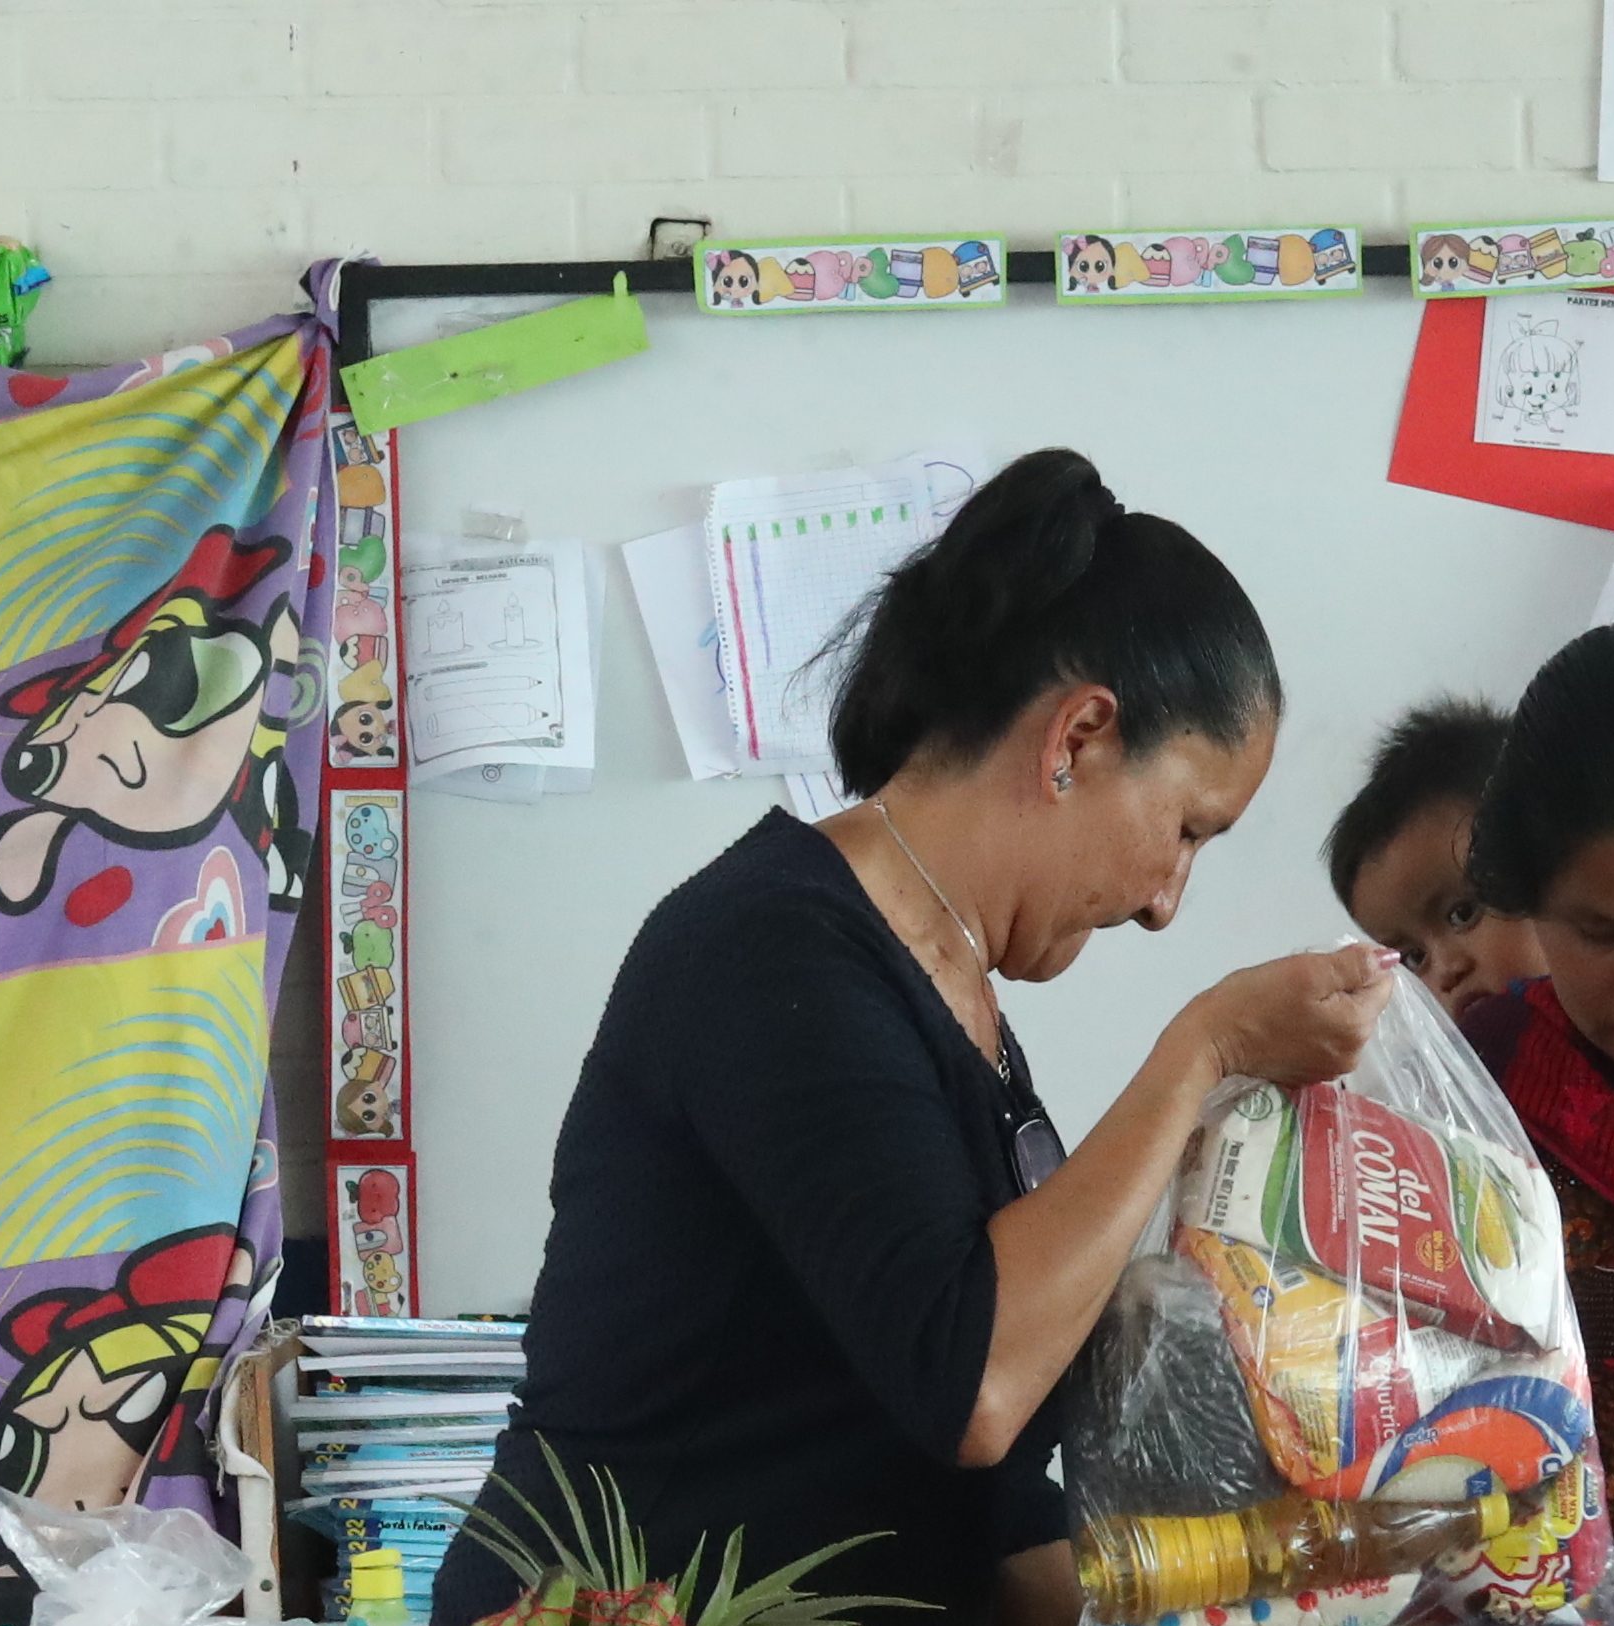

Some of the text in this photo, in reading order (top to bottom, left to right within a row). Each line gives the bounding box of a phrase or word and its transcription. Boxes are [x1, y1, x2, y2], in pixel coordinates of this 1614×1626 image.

[1567, 297, 1599, 307] PARTES
[1351, 1129, 1401, 1249] COMAL
[1398, 1167, 1432, 1222] del
